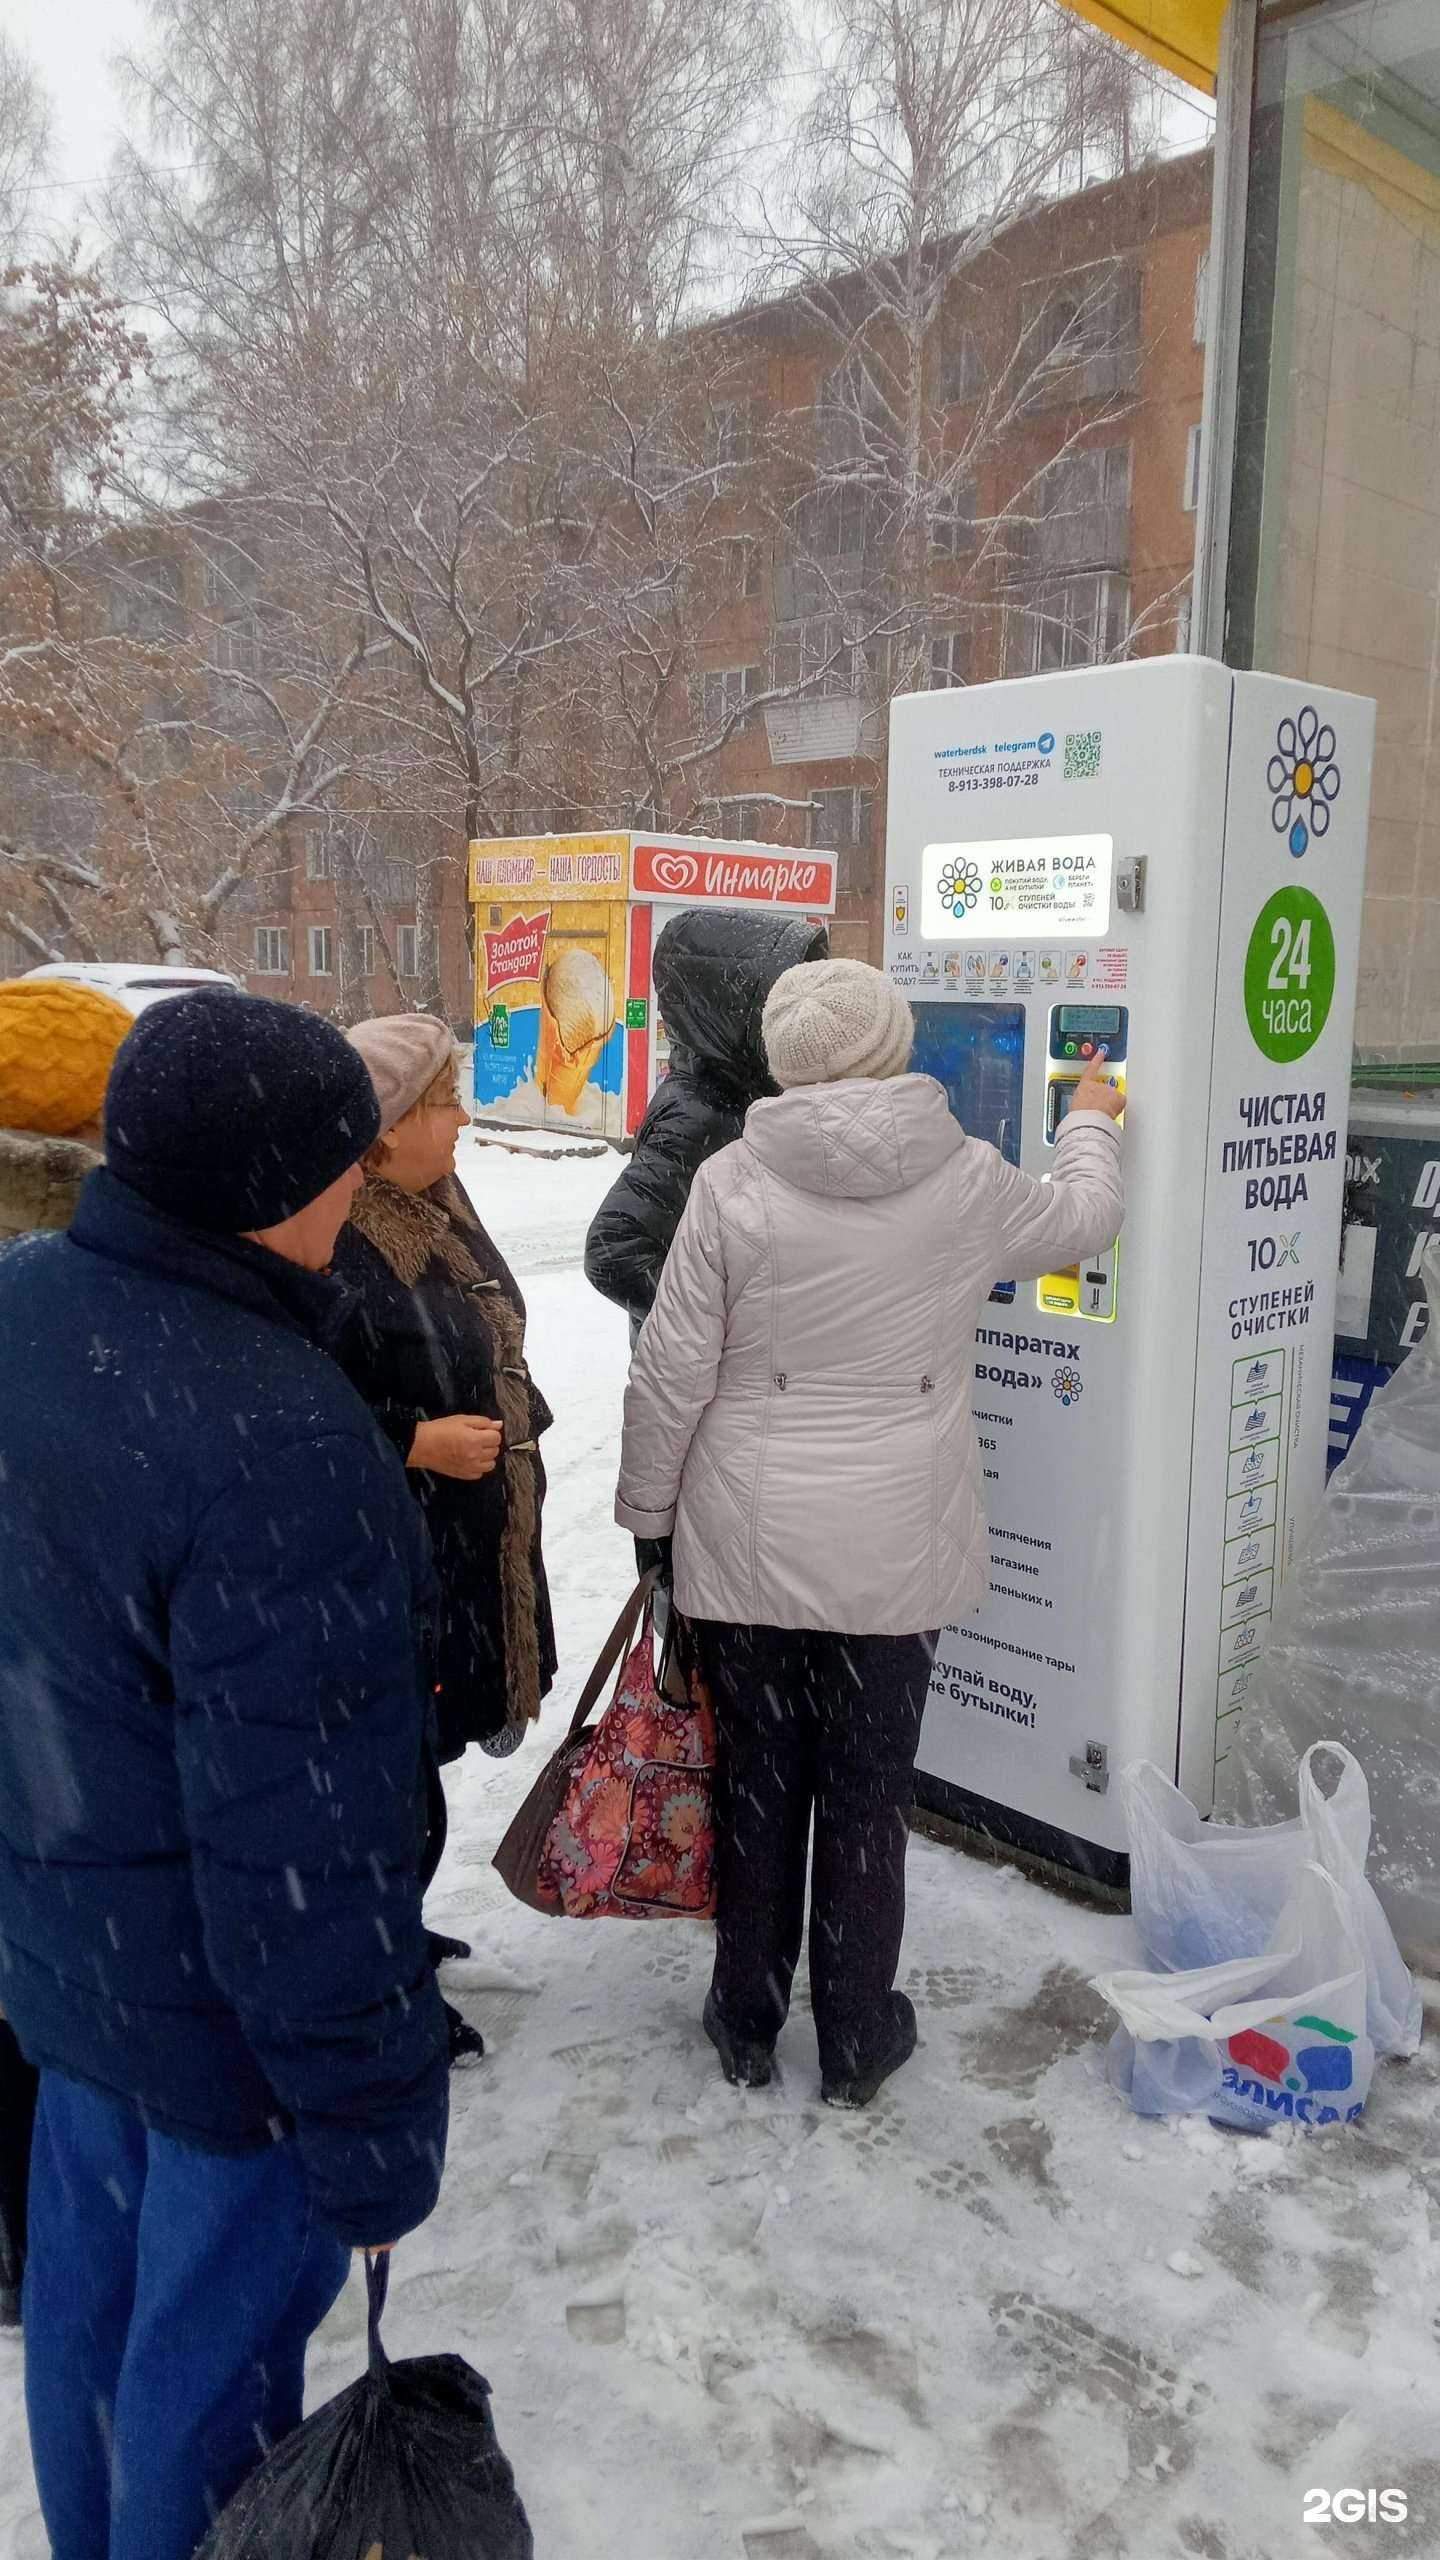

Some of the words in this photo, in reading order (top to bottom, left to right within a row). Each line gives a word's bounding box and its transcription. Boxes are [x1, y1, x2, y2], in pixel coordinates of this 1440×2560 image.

[934, 745, 987, 758] waterberdsk
[994, 740, 1036, 753] telegram
[938, 763, 995, 777] ТЕХНИЧЕСКАЯ
[997, 759, 1051, 773] ПОДДЕРЖКА
[949, 774, 1039, 792] 8-913-398-07-28
[550, 856, 572, 882] НАША
[577, 854, 621, 882] ГОРДОСТЬ!
[990, 858, 1046, 873] ЖИВАЯ
[1052, 856, 1097, 871] ВОДА
[704, 856, 816, 904] Инмарко
[1018, 893, 1056, 902] СТУПЕНЕЙ
[1018, 902, 1052, 910] ОЧИСТКИ
[1053, 901, 1076, 910] ВОДЫ
[491, 931, 539, 959] Золотой
[897, 951, 913, 961] КАК
[1267, 917, 1312, 990] 24
[490, 951, 539, 975] Стандарт
[890, 964, 919, 973] КУПИТЬ
[1262, 998, 1312, 1034] часа
[1240, 1092, 1326, 1128] ЧИСТАЯ
[1222, 1130, 1337, 1173] ПИТЬЕВАЯ
[1245, 1173, 1309, 1211] ВОДА
[1228, 1280, 1315, 1318] СТУПЕНЕЙ
[1231, 1306, 1310, 1340] ОЧИСТКИ
[975, 1363, 1043, 1389] вода»
[972, 1409, 1013, 1427] чистки
[983, 1468, 999, 1480] ая
[988, 1526, 1052, 1551] кипячения
[1044, 1599, 1053, 1609] и
[960, 1628, 1043, 1662] озонирование
[1045, 1656, 1076, 1673] тары
[949, 1682, 1035, 1728] бутылки!
[989, 1680, 1038, 1710] воду,
